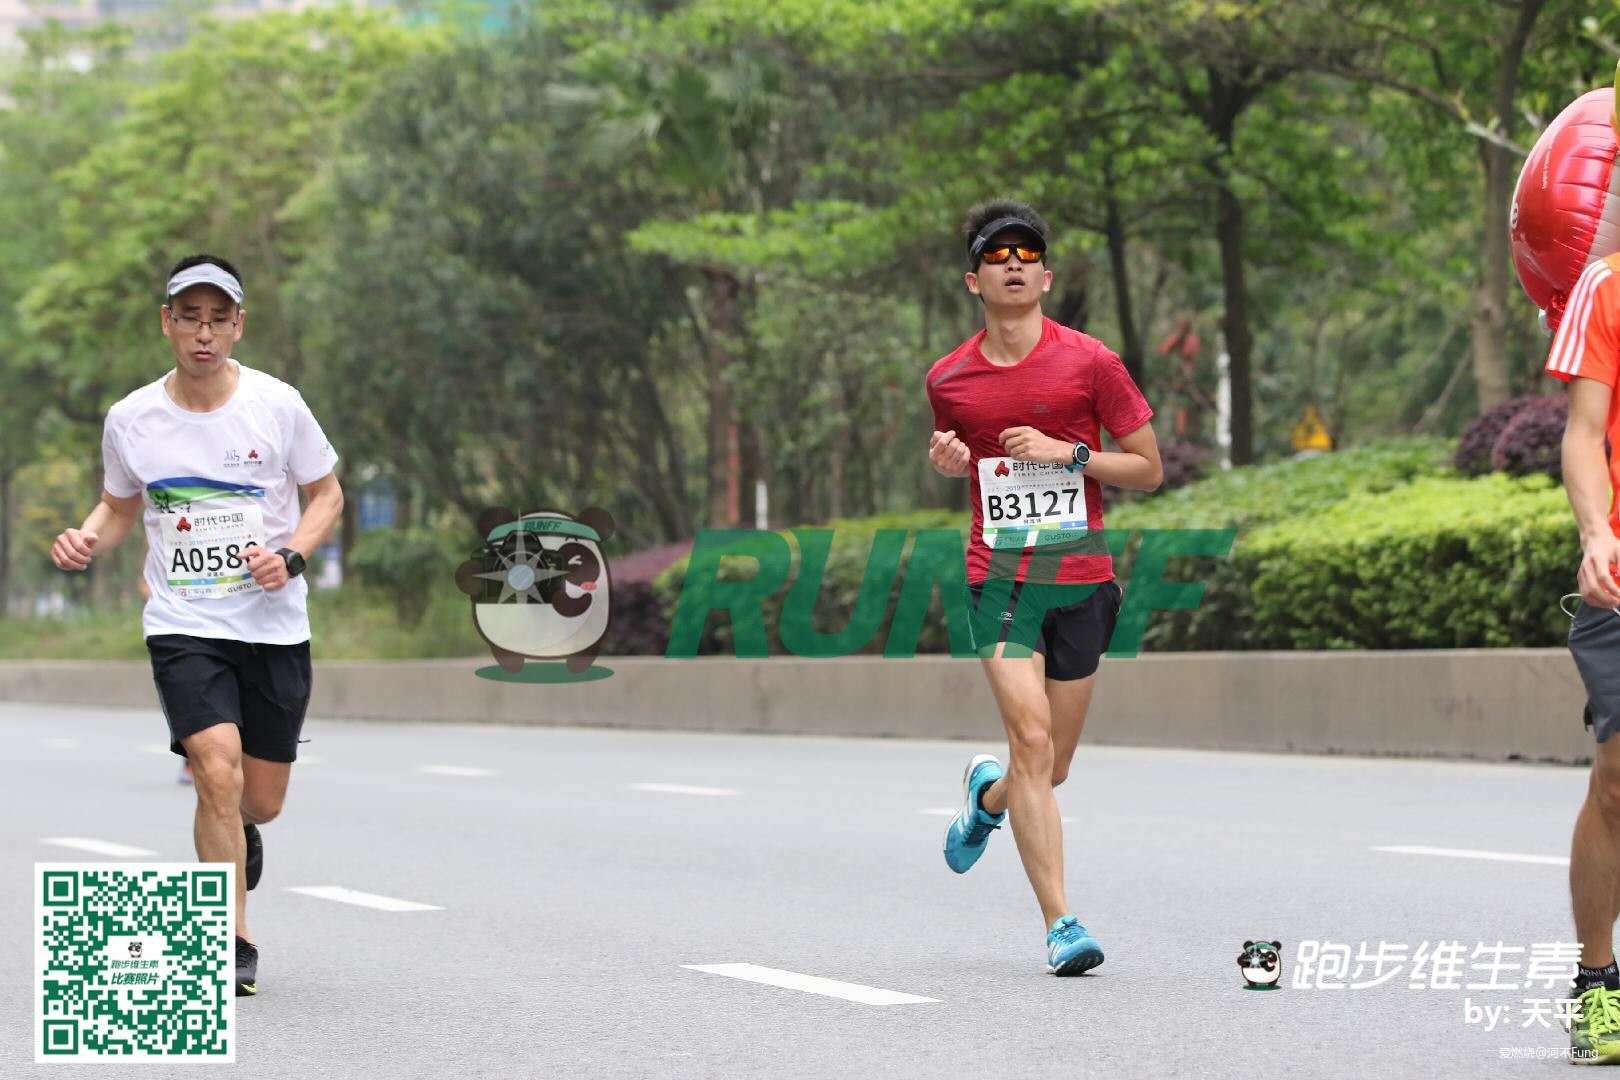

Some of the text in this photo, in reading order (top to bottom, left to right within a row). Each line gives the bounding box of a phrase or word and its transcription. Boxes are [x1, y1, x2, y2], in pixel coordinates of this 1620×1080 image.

[194, 512, 244, 527] 时代中国
[988, 488, 1079, 521] B3127
[172, 541, 258, 573] A058
